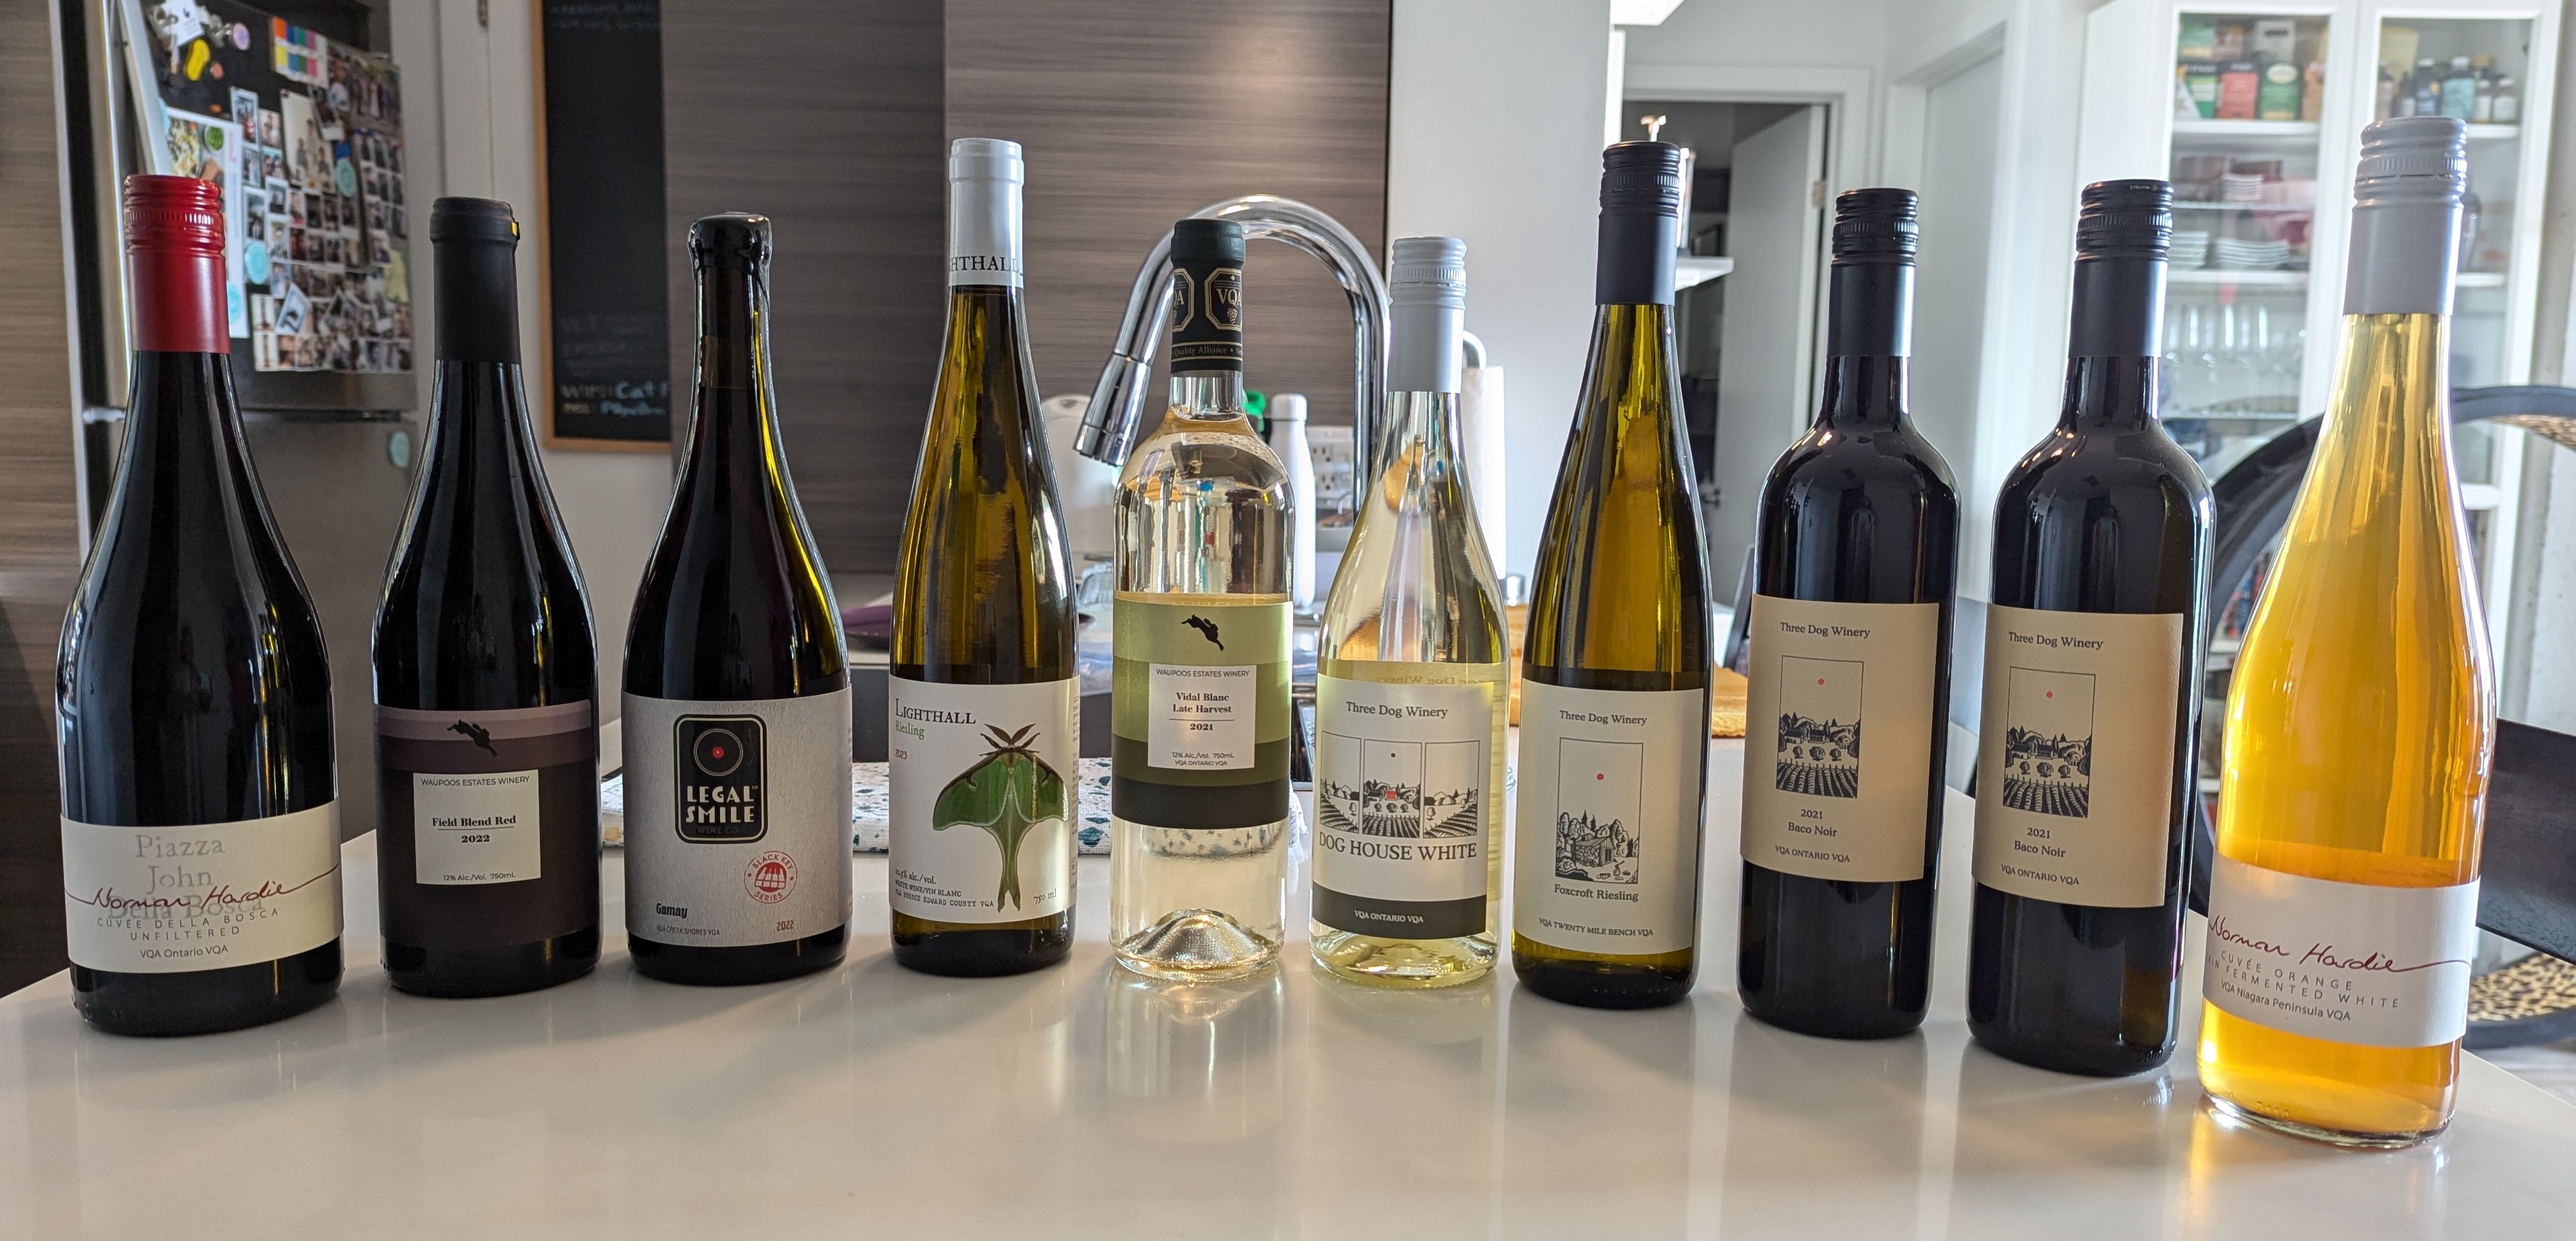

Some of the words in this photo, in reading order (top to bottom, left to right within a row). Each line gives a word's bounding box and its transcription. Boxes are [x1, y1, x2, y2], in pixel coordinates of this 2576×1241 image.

[1216, 289, 1241, 308] VQA
[1781, 622, 1805, 633] Three
[1808, 625, 1828, 637] Dog
[1831, 627, 1870, 639] Winery
[2009, 632, 2034, 644] Three
[2036, 635, 2057, 648] Dog
[2060, 637, 2103, 650] Winery
[1156, 669, 1192, 677] WAUPOOS
[1176, 692, 1200, 701] Vidal
[1203, 693, 1230, 701] Blanc
[895, 698, 976, 724] LIGHTHALL
[1172, 704, 1193, 712] Late
[1346, 701, 1376, 714] Three
[1379, 704, 1402, 718] Dog
[1406, 706, 1448, 719] Winery
[1560, 710, 1586, 721] Three
[1588, 713, 1609, 725] Dog
[1611, 715, 1648, 726] Winery
[895, 720, 924, 740] Riesling
[463, 778, 496, 786] ESTATES
[498, 776, 530, 784] WINERY
[687, 786, 755, 803] LEGAL
[432, 818, 457, 826] Field
[461, 817, 491, 826] Blend
[494, 815, 516, 825] Red
[686, 805, 755, 823] SMILE
[1800, 809, 1823, 819] 2021
[1788, 821, 1812, 834] Baco
[1814, 825, 1838, 837] Noir
[2027, 827, 2050, 839] 2021
[135, 834, 226, 858] Piazza
[461, 834, 490, 843] 2022
[1319, 831, 1346, 853] DOG
[1350, 840, 1413, 860] HOUSE
[1417, 842, 1477, 861] WHITE
[1775, 844, 1790, 855] VQA
[1791, 848, 1830, 860] ONTARIO
[1832, 853, 1851, 863] VQA
[2014, 840, 2039, 853] Baco
[2041, 845, 2066, 857] Noir
[752, 853, 779, 869] BLACK
[780, 856, 793, 869] KEY
[146, 865, 213, 895] John
[490, 872, 516, 880] 750mL
[2001, 864, 2016, 875] VQA
[2017, 869, 2057, 882] ONTARIO
[2060, 875, 2080, 886] VQA
[93, 885, 192, 910] Norman
[201, 880, 289, 910] Hardie
[755, 891, 783, 901] SERIES
[923, 895, 947, 906] EDWARD
[937, 889, 962, 897] BLANC
[1033, 894, 1046, 905] 750
[1047, 888, 1057, 899] ml
[1554, 884, 1593, 899] Foxcroft
[1597, 890, 1639, 902] Riesling
[108, 895, 172, 920] Della
[183, 894, 263, 918] Bosca
[656, 902, 688, 918] Gamay
[155, 917, 210, 929] DELLA
[224, 908, 279, 924] BOSCA
[1353, 910, 1370, 920] VQA
[1370, 913, 1406, 922] ONTARIO
[1407, 915, 1424, 924] VQA
[1539, 917, 1552, 927] VQA
[1553, 921, 1586, 933] TWENTY
[1587, 926, 1607, 934] MILE
[130, 926, 240, 941] UNFILTERED
[777, 920, 794, 932] 2022
[140, 949, 162, 958] VQA
[164, 948, 203, 957] Ontario
[205, 945, 229, 955] VQA
[2209, 915, 2290, 956] Norman
[2299, 943, 2402, 973] Hardie
[2221, 950, 2262, 973] CUVÉE
[2274, 968, 2352, 991] ORANGE
[2226, 965, 2324, 1000] FERMENTED
[2339, 993, 2398, 1008] WHITE
[2221, 979, 2235, 994] VQA
[2237, 987, 2269, 1006] Niagara
[2273, 998, 2324, 1017] Peninsula
[2327, 1009, 2351, 1021] VQA
